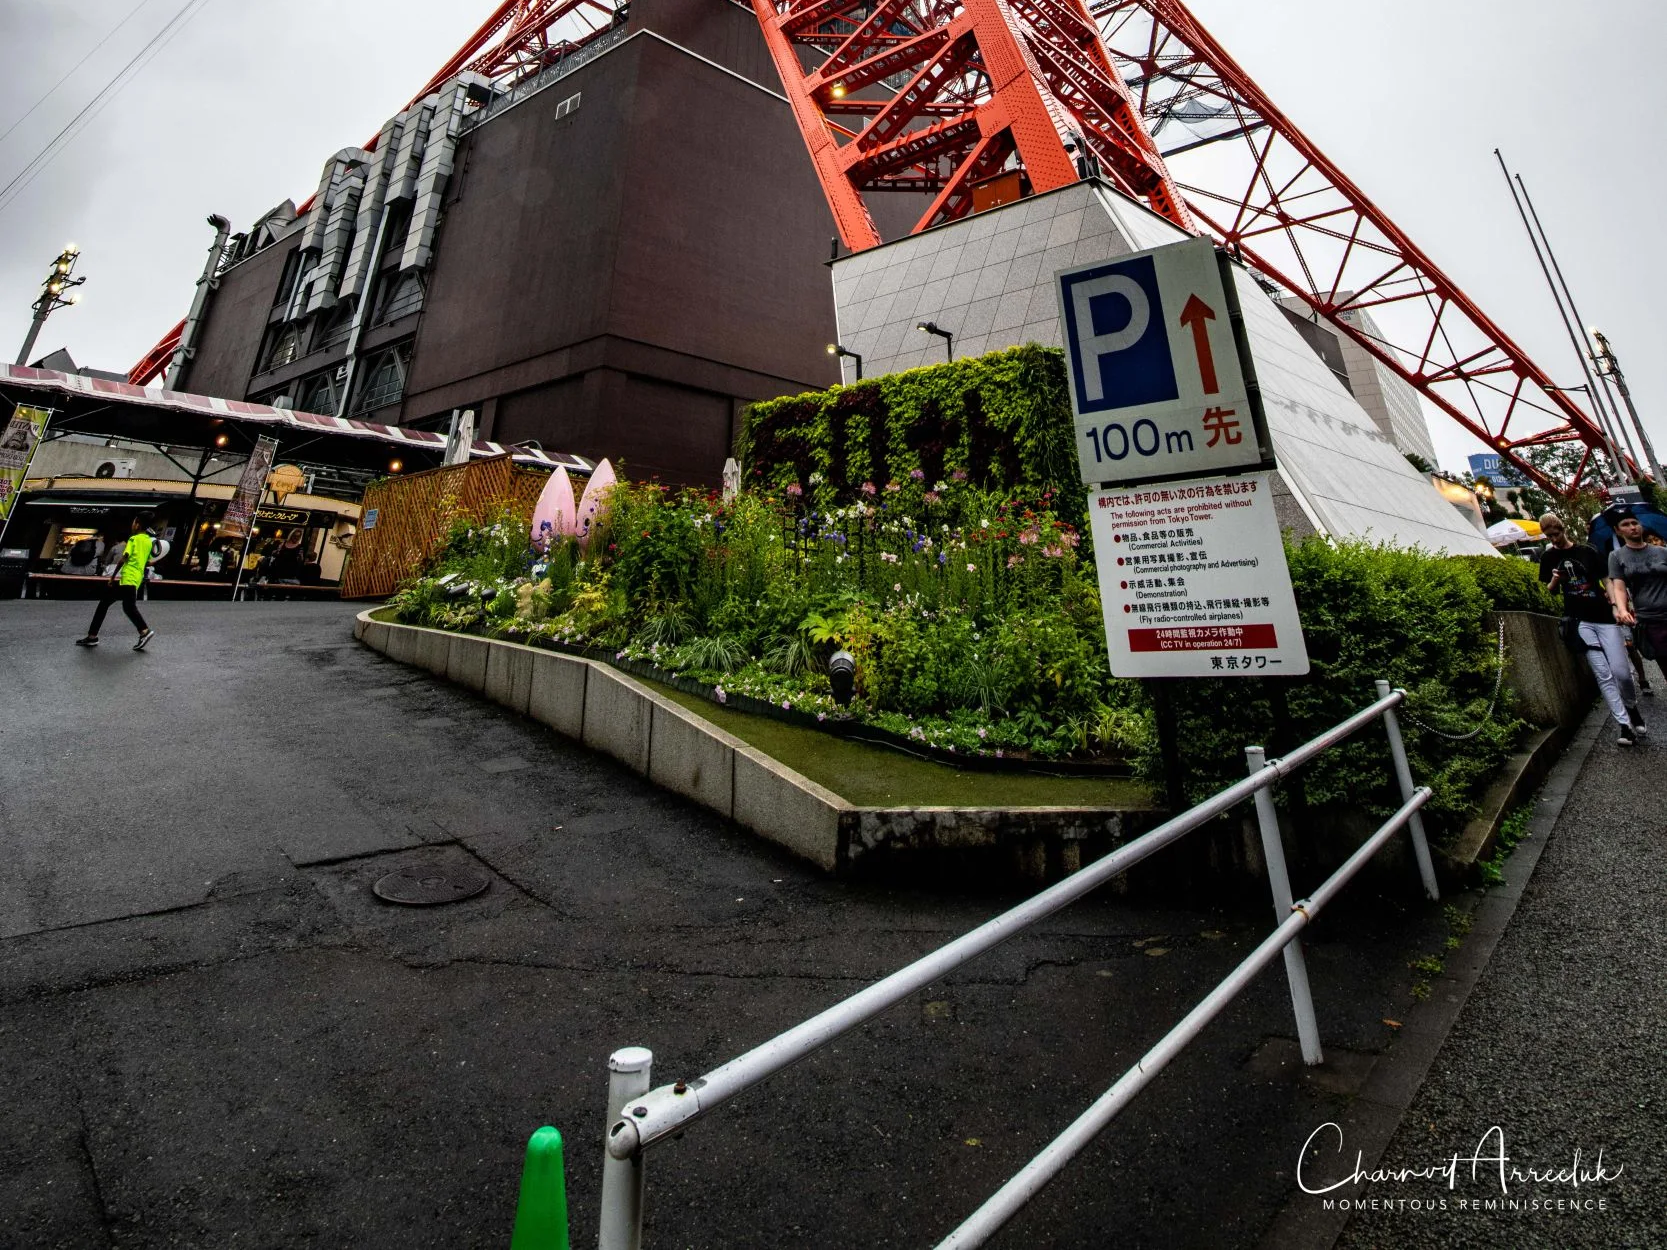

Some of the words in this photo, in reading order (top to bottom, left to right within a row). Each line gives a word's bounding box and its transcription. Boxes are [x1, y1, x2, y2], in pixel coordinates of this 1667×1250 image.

[1070, 274, 1150, 402] P
[1202, 406, 1243, 448] 先
[1098, 481, 1258, 509] 構内では、許可の無い次の行為を禁じます
[1110, 511, 1124, 520] The
[1125, 509, 1155, 519] following
[1157, 507, 1172, 516] acts
[1173, 506, 1185, 514] are
[1186, 501, 1223, 514] prohibited
[1224, 498, 1252, 509] without
[1111, 519, 1148, 531] permission
[1149, 517, 1166, 526] from
[1167, 515, 1189, 525] Tokyo
[1189, 513, 1214, 522] Tower.
[1121, 527, 1194, 543] 物品、食品等の販売
[1128, 540, 1169, 551] (Commercial
[1170, 536, 1204, 548] Activities)
[1125, 551, 1208, 566] 営業用写真撮影、宣伝
[1133, 564, 1169, 575] (Commercial
[1169, 561, 1207, 573] photography
[1207, 560, 1220, 569] and
[1220, 556, 1259, 568] Advertising)
[1128, 576, 1186, 590] 示威活動、集会
[1135, 587, 1188, 600] (Demonstration)
[1139, 614, 1153, 625] (Fly
[1153, 612, 1207, 624] radio-controlled
[1208, 609, 1244, 622] airplanes)
[1156, 626, 1244, 639] 24時間監視カメラ作動中
[1184, 639, 1192, 648] in
[1192, 639, 1223, 649] operation
[1223, 637, 1243, 647] 24/7)
[1210, 655, 1282, 670] 東京タワー
